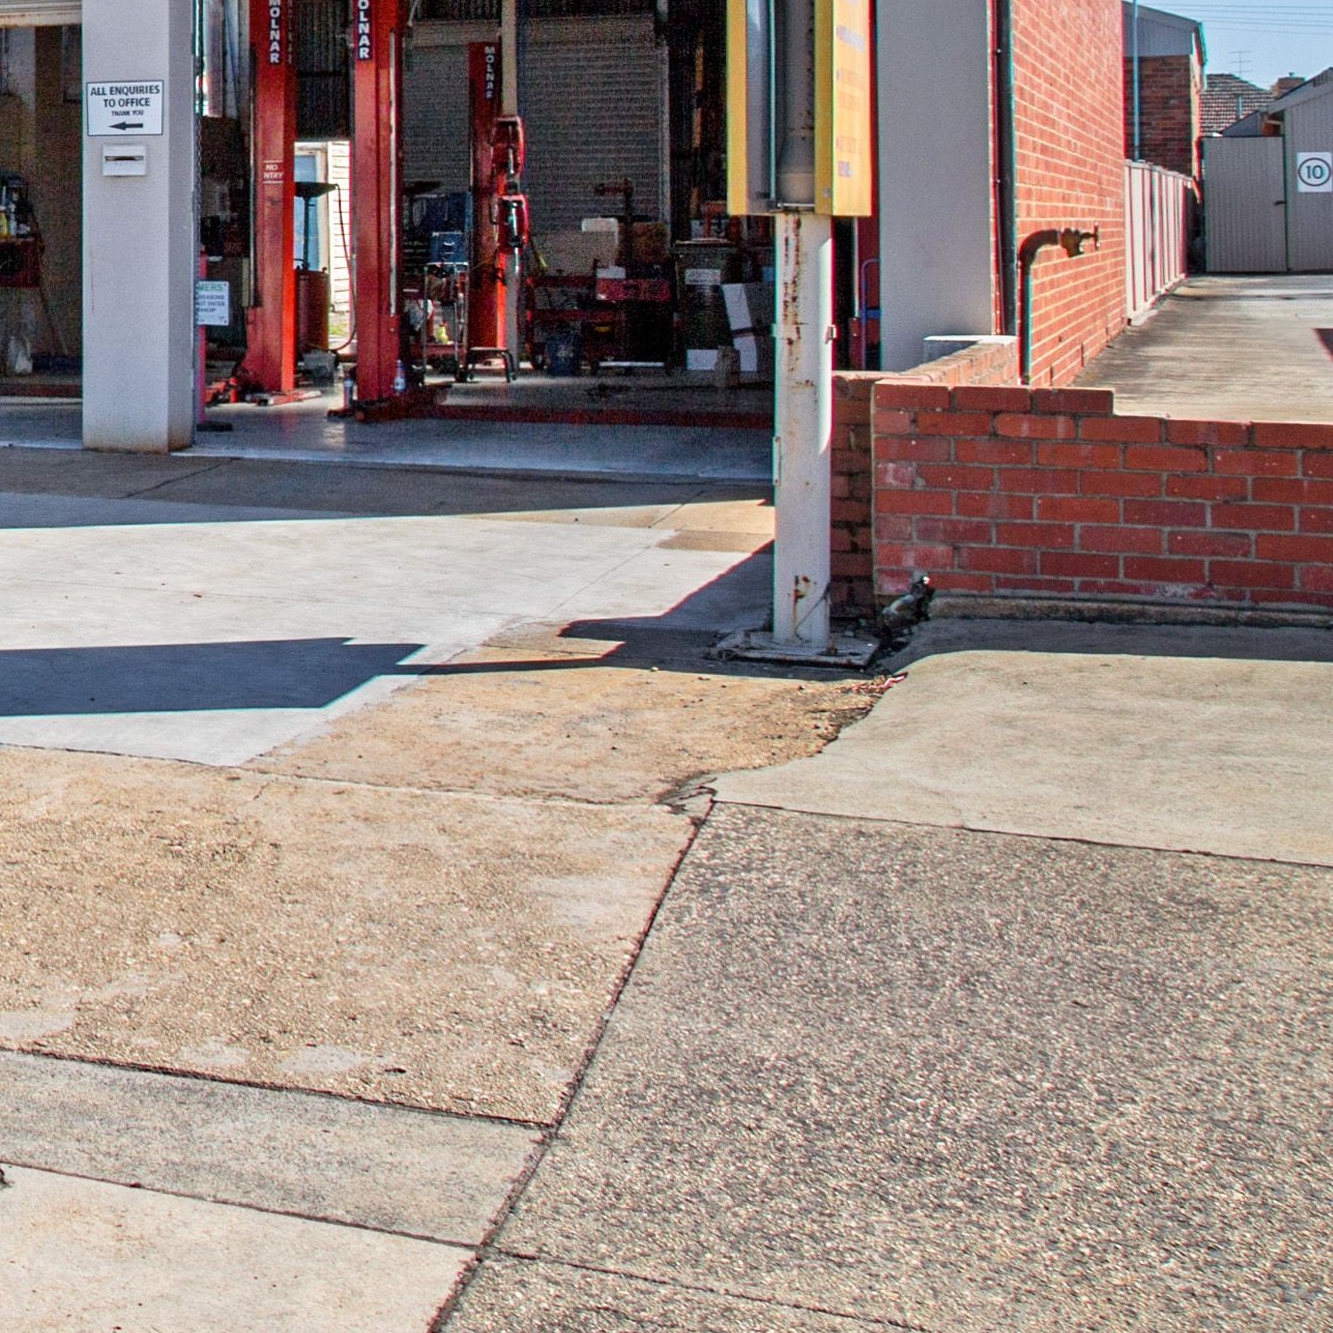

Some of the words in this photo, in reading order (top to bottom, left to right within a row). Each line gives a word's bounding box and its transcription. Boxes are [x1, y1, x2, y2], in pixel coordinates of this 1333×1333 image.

[90, 87, 106, 96] ALL
[109, 85, 160, 96] ENQUIRIES
[103, 98, 115, 108] TO
[118, 97, 150, 108] OFFICE
[1305, 165, 1323, 180] 10
